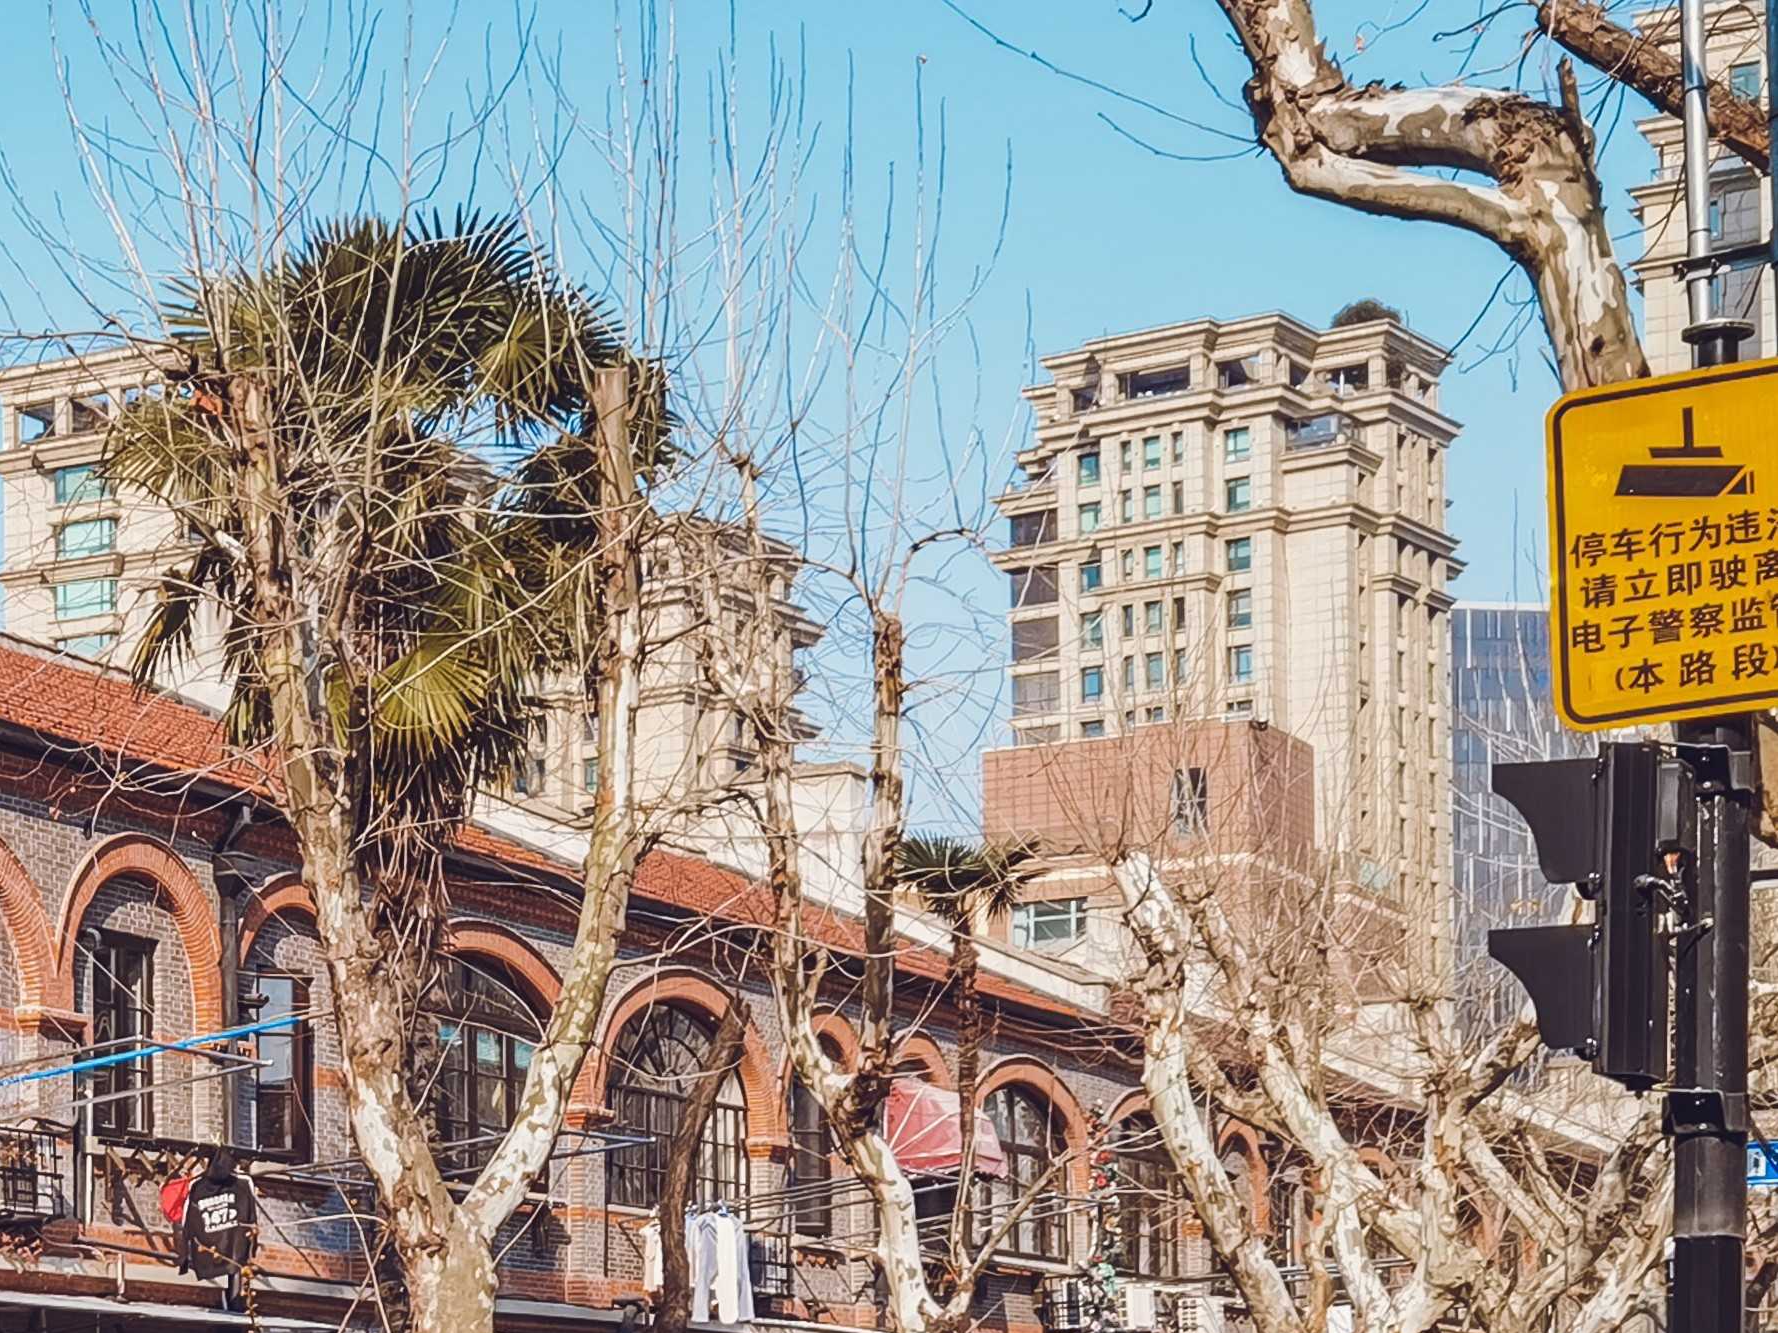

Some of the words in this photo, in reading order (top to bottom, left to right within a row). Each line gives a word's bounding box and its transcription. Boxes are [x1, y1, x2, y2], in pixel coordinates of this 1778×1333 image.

[1571, 592, 1778, 654] 电子警察监
